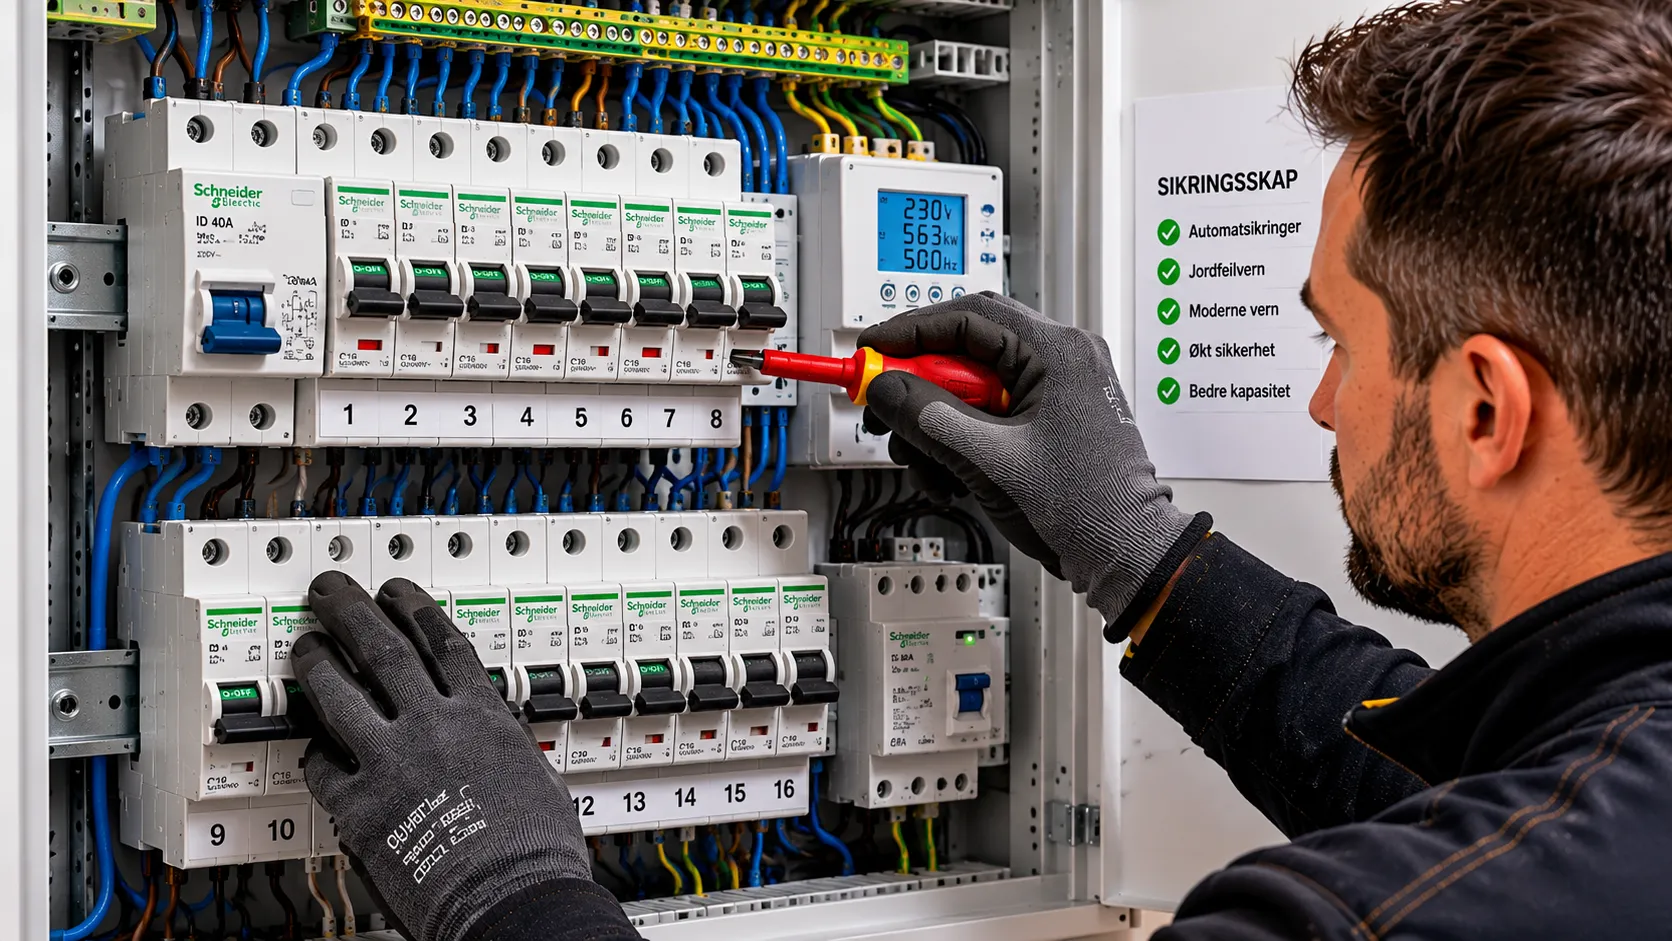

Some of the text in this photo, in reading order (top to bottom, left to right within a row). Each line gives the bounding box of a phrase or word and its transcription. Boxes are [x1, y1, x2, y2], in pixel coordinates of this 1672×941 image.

[193, 182, 263, 199] Schneider
[1157, 169, 1298, 196] SIKRINGSSKAP
[196, 215, 208, 227] ID
[211, 216, 234, 228] 40A
[1188, 220, 1302, 239] Automatsikringer
[1188, 262, 1265, 279] Jordfeilvern
[1189, 303, 1280, 318] Moderne vern
[1189, 342, 1276, 359] Økt sikkerhet
[1189, 383, 1291, 402] Bedre kapasitet
[343, 403, 353, 425] 1
[404, 404, 418, 426] 2
[463, 405, 477, 426] 3
[520, 406, 535, 427] 4
[575, 407, 588, 428] 5
[621, 408, 633, 428] 6
[663, 408, 676, 428] 7
[710, 409, 723, 429] 8
[675, 787, 697, 807] 14
[724, 783, 746, 803] 15
[774, 779, 795, 799] 16
[573, 795, 595, 816] 12
[623, 791, 646, 812] 13
[209, 823, 226, 846] 9
[267, 818, 295, 841] 10
